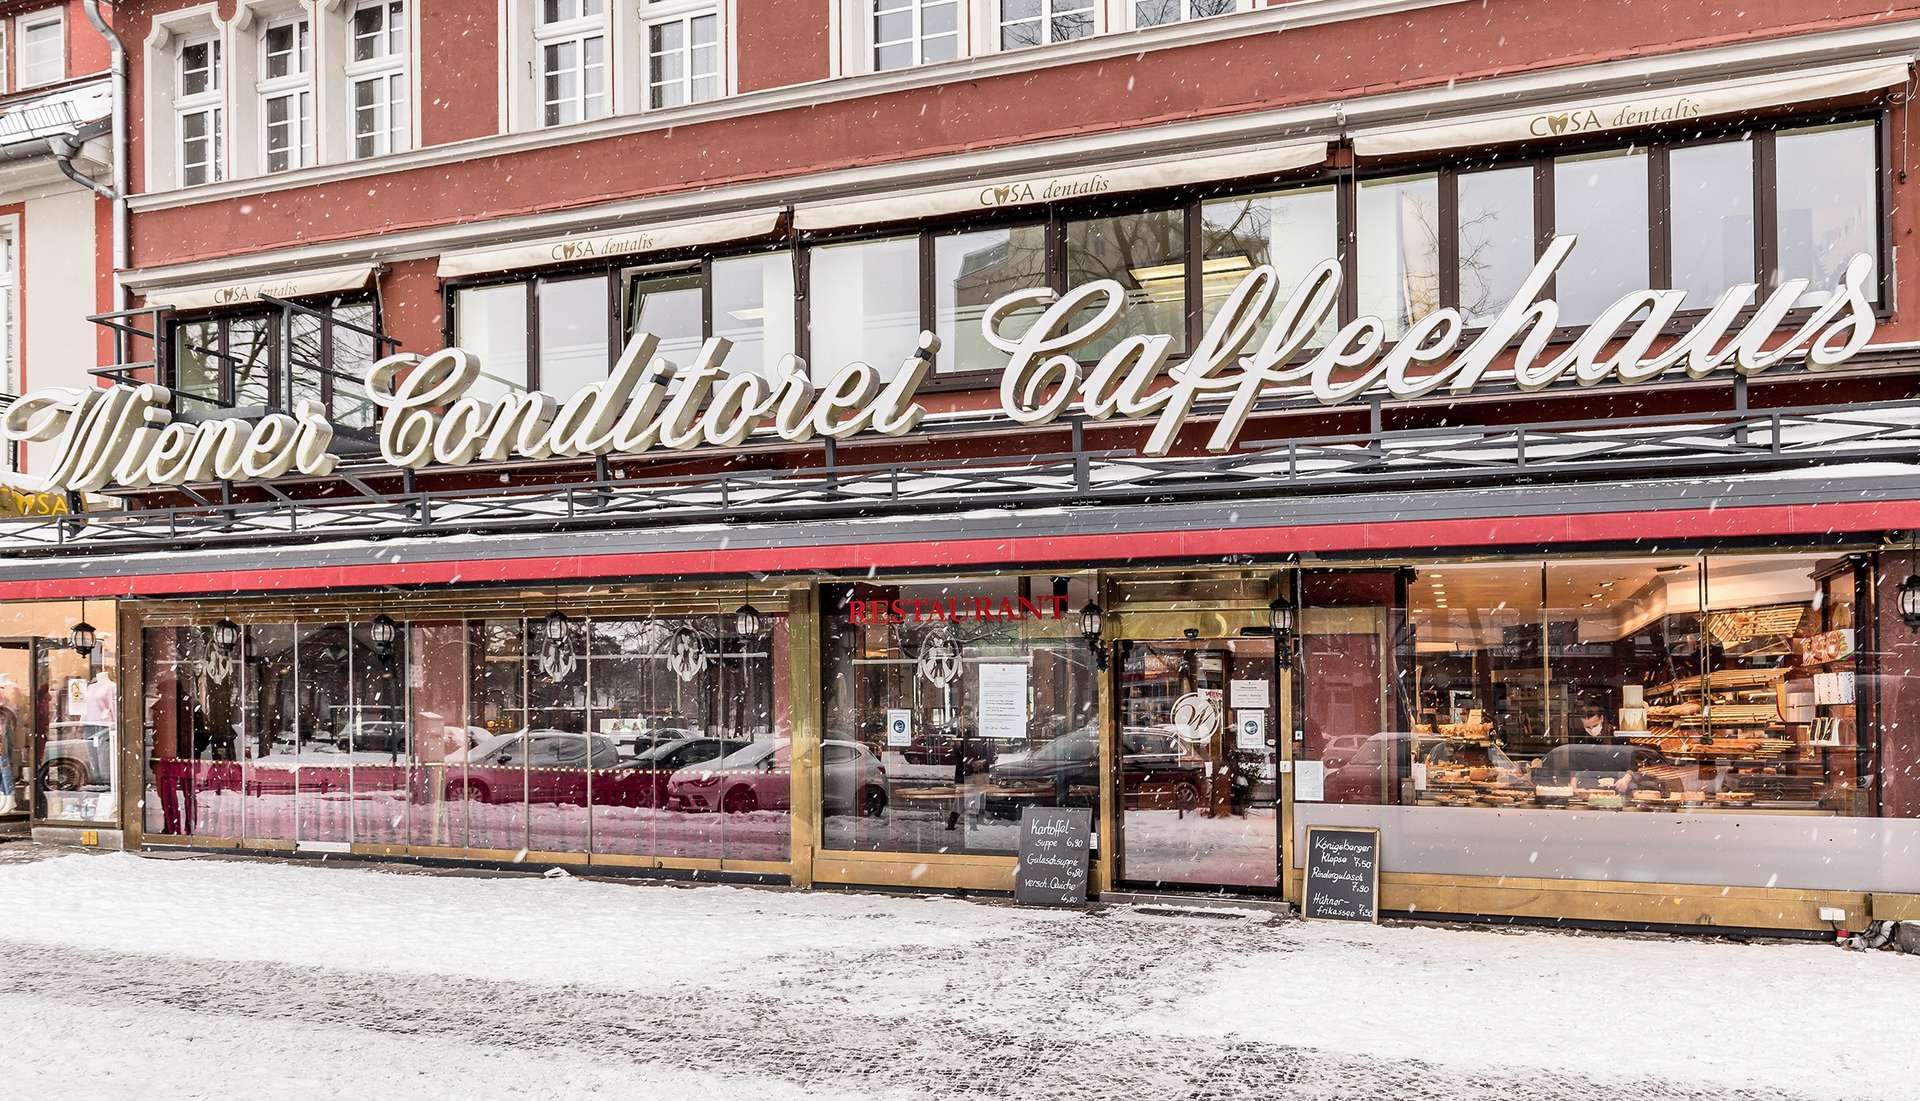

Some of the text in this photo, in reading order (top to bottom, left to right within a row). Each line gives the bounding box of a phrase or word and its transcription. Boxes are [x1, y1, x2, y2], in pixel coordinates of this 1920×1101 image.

[1612, 98, 1700, 127] dentalis
[1043, 174, 1109, 199] dentalis
[601, 233, 653, 255] dentalis
[2, 234, 1876, 493] Wiener Conditorei Caffeehaus
[848, 594, 1069, 625] RESTAURANT
[1030, 817, 1077, 837] Kartoffel-
[1035, 839, 1058, 852] suppe
[1320, 851, 1348, 866] Klopse
[1311, 866, 1364, 883] Rindergulasch
